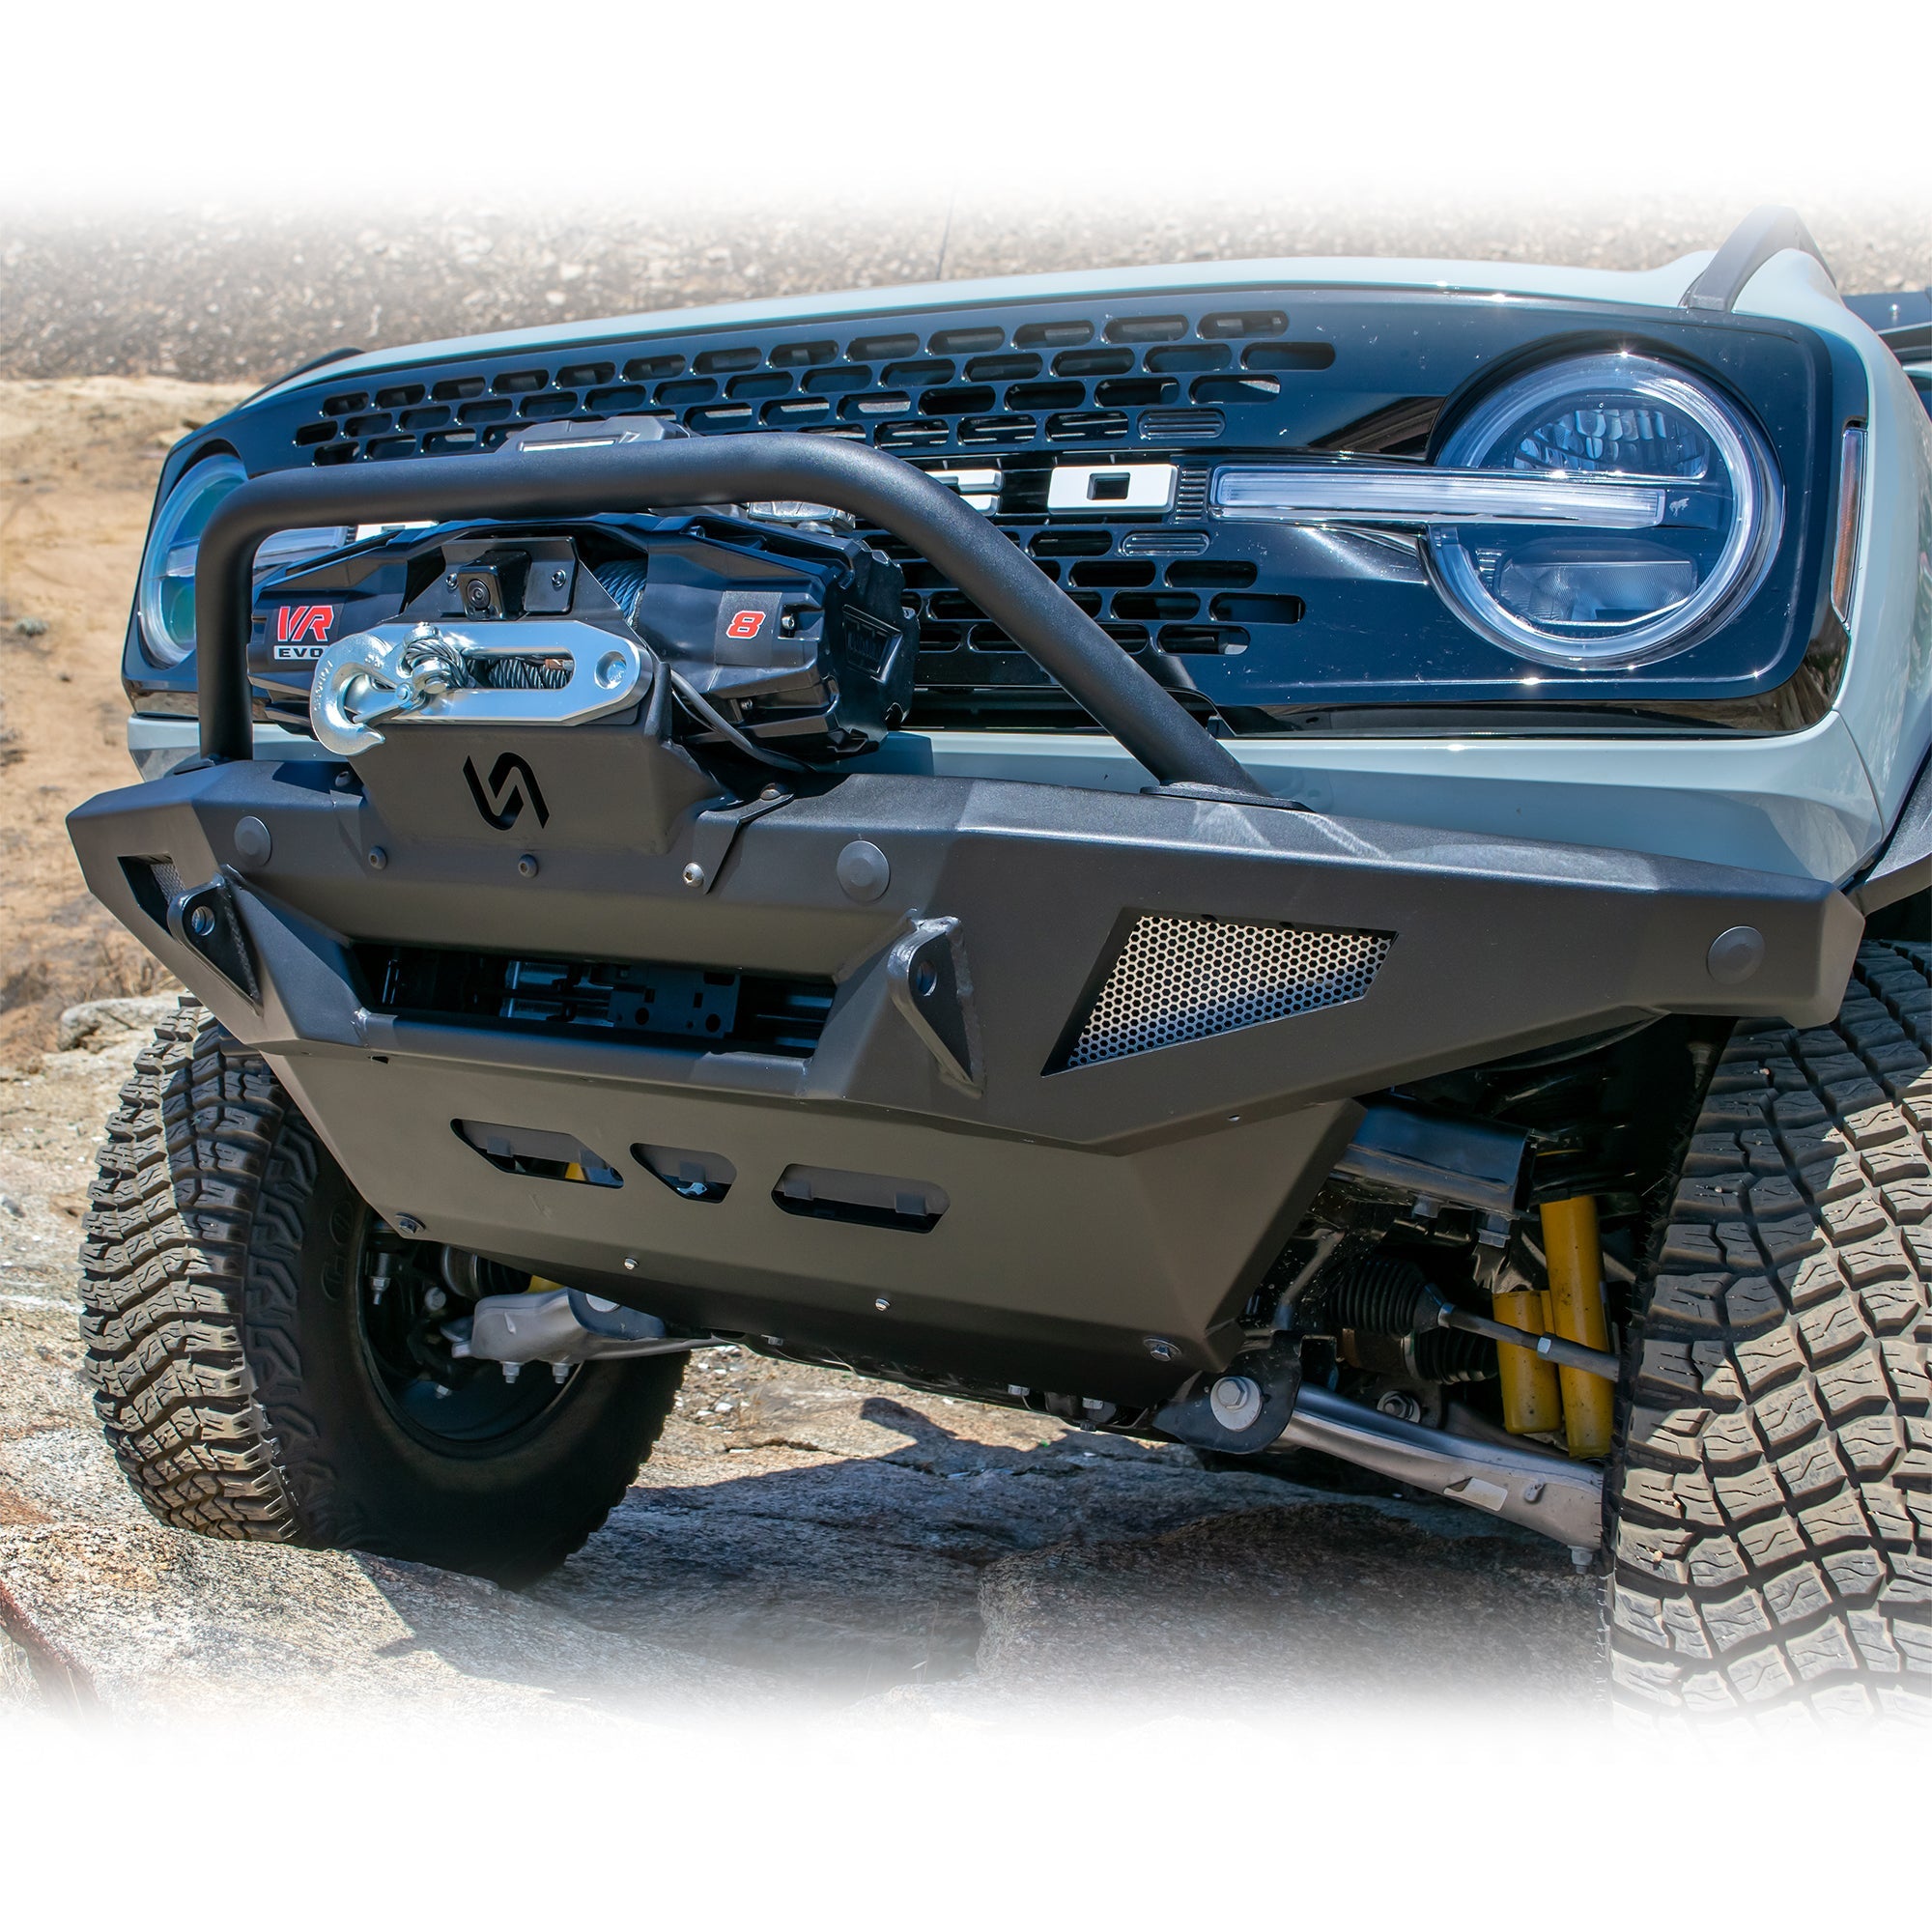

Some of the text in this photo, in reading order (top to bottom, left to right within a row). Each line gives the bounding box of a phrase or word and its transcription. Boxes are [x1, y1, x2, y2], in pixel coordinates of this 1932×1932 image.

[277, 605, 334, 642] VR
[725, 610, 766, 639] 8
[278, 647, 326, 658] EVO
